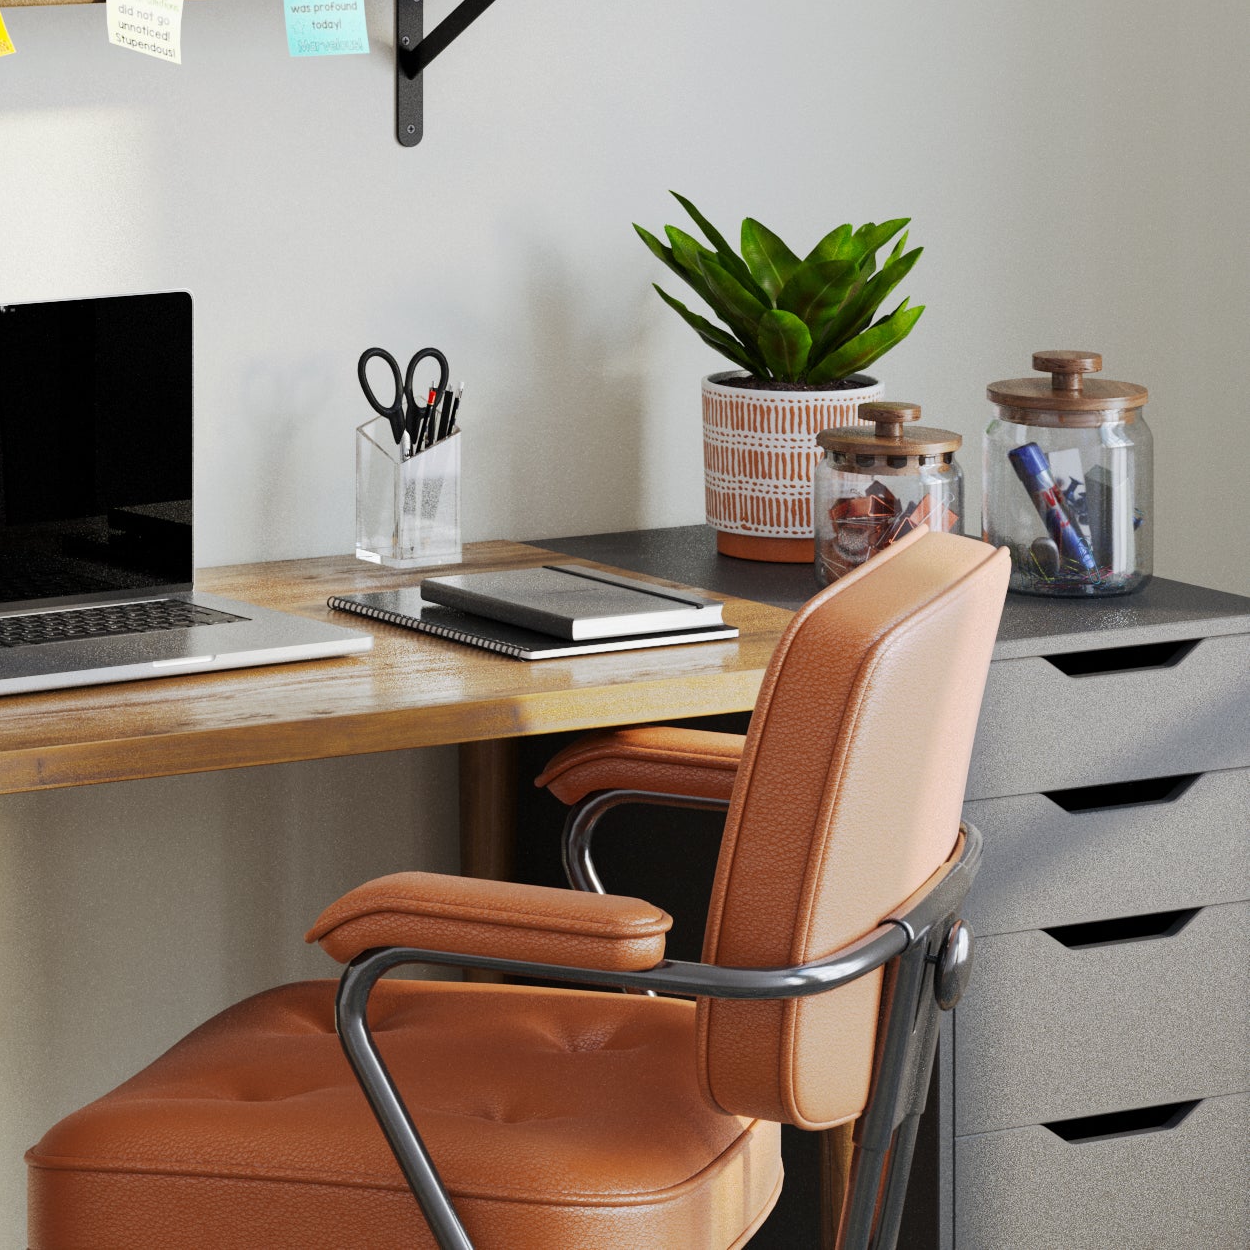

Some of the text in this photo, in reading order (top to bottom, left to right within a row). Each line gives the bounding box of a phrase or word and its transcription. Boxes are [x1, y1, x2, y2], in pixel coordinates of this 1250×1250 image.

[118, 5, 170, 26] did not go
[314, 2, 358, 14] profound
[118, 21, 170, 42] unnoticed!
[312, 20, 342, 30] today!
[116, 32, 176, 58] Stupendous!
